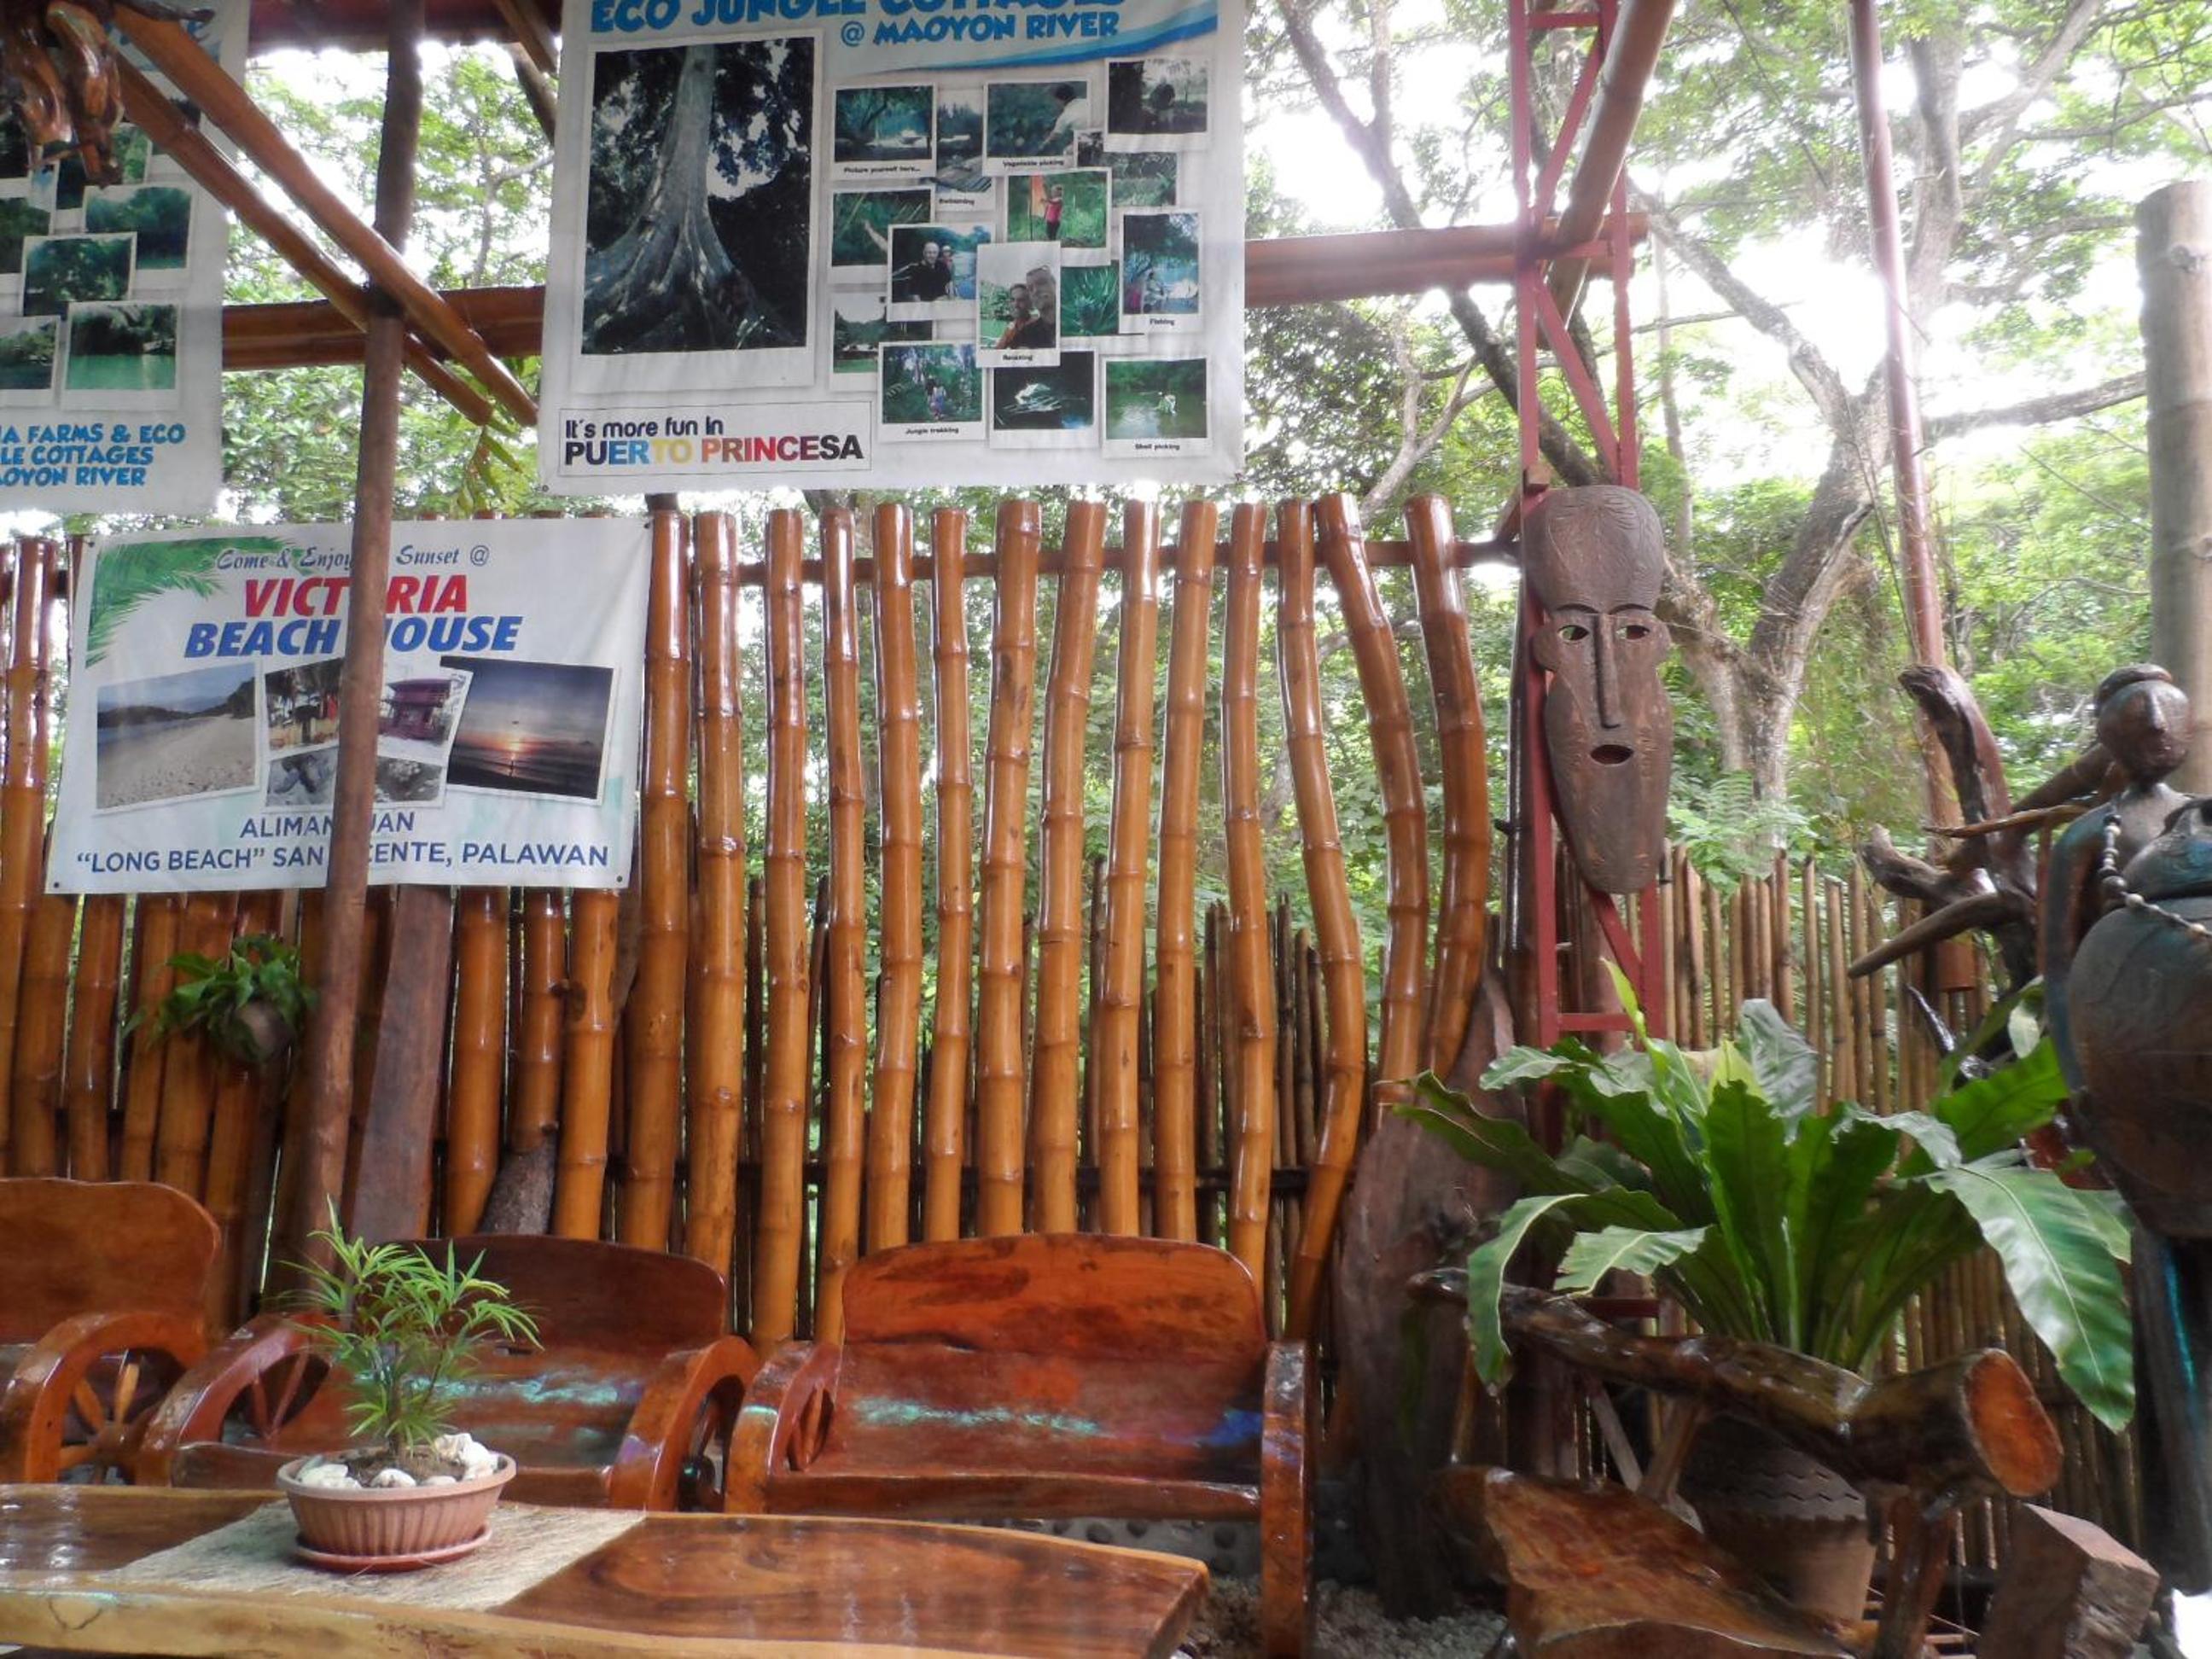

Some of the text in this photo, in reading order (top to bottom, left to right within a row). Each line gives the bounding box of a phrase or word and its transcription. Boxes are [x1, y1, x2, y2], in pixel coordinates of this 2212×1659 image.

[591, 0, 681, 32] ECO
[841, 11, 1121, 47] @ MAOYON RIVER
[27, 422, 104, 444] FARMS
[110, 423, 131, 443] &
[139, 423, 186, 444] ECO
[602, 421, 659, 439] more
[665, 416, 699, 437] fun
[31, 445, 154, 465] COTTAGES
[565, 434, 864, 466] PUERTO PRINCESA
[75, 466, 147, 486] RIVER
[217, 547, 268, 570] Come
[275, 548, 292, 568] &
[395, 544, 461, 566] Sunset
[469, 544, 491, 568] @
[244, 573, 468, 618] VICTRIA
[183, 615, 523, 659] BEACH OUSE
[239, 811, 416, 839] ALIMANAN
[272, 846, 324, 867] SAN
[462, 841, 609, 867] PALAWAN
